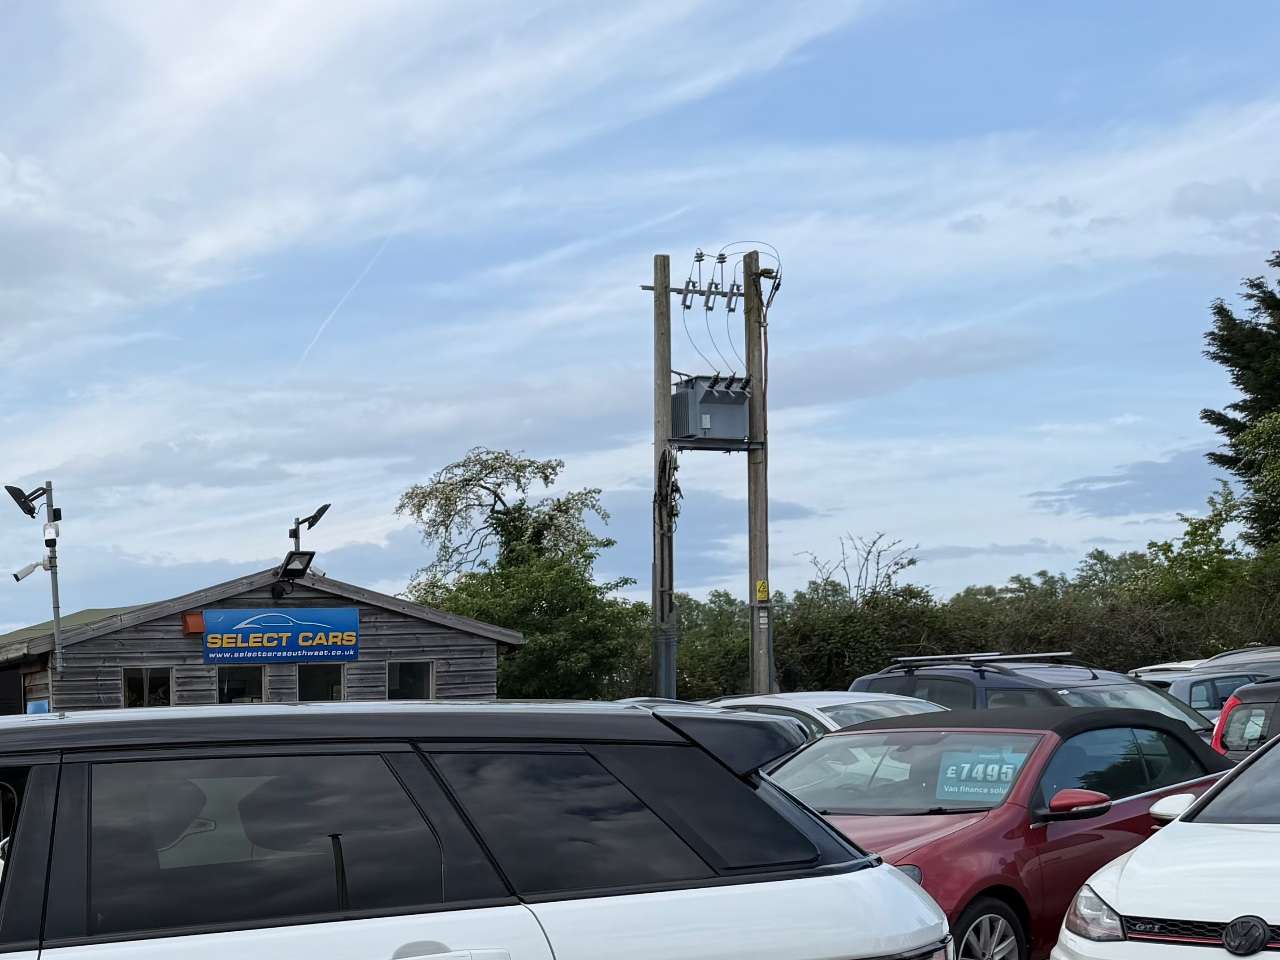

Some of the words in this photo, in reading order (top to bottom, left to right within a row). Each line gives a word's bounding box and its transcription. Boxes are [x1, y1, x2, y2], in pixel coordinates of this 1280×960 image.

[207, 633, 292, 648] SELECT
[298, 632, 357, 647] CARS
[208, 649, 355, 658] www.selectcarssouthwest.co.uk
[946, 763, 1014, 781] £7495
[944, 785, 958, 793] Van
[960, 785, 987, 793] finance
[1135, 923, 1161, 932] GTI
